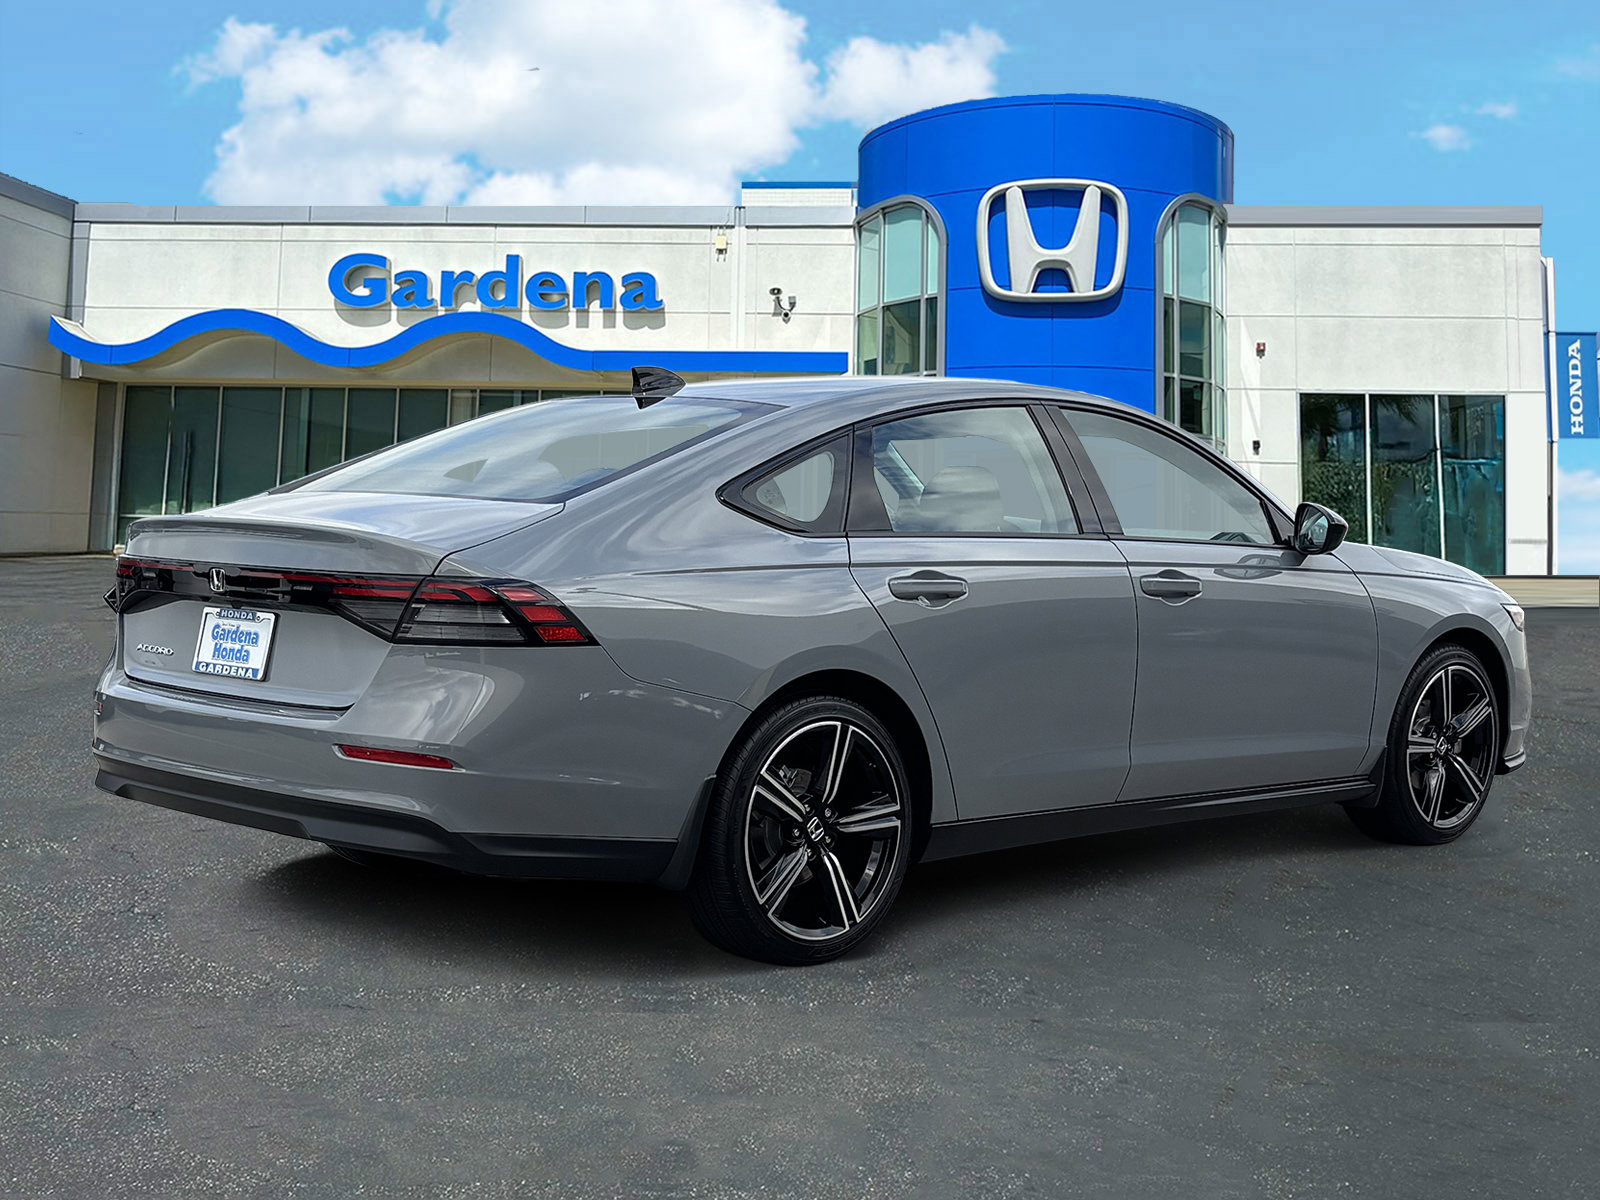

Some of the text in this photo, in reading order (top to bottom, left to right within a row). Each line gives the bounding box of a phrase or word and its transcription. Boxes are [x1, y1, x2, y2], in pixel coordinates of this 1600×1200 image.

[328, 253, 664, 310] Gardena
[1567, 339, 1584, 435] HONDA
[221, 609, 253, 619] HONDA
[211, 623, 259, 645] Gardena
[212, 642, 250, 663] Honda
[198, 662, 253, 678] GARDENA
